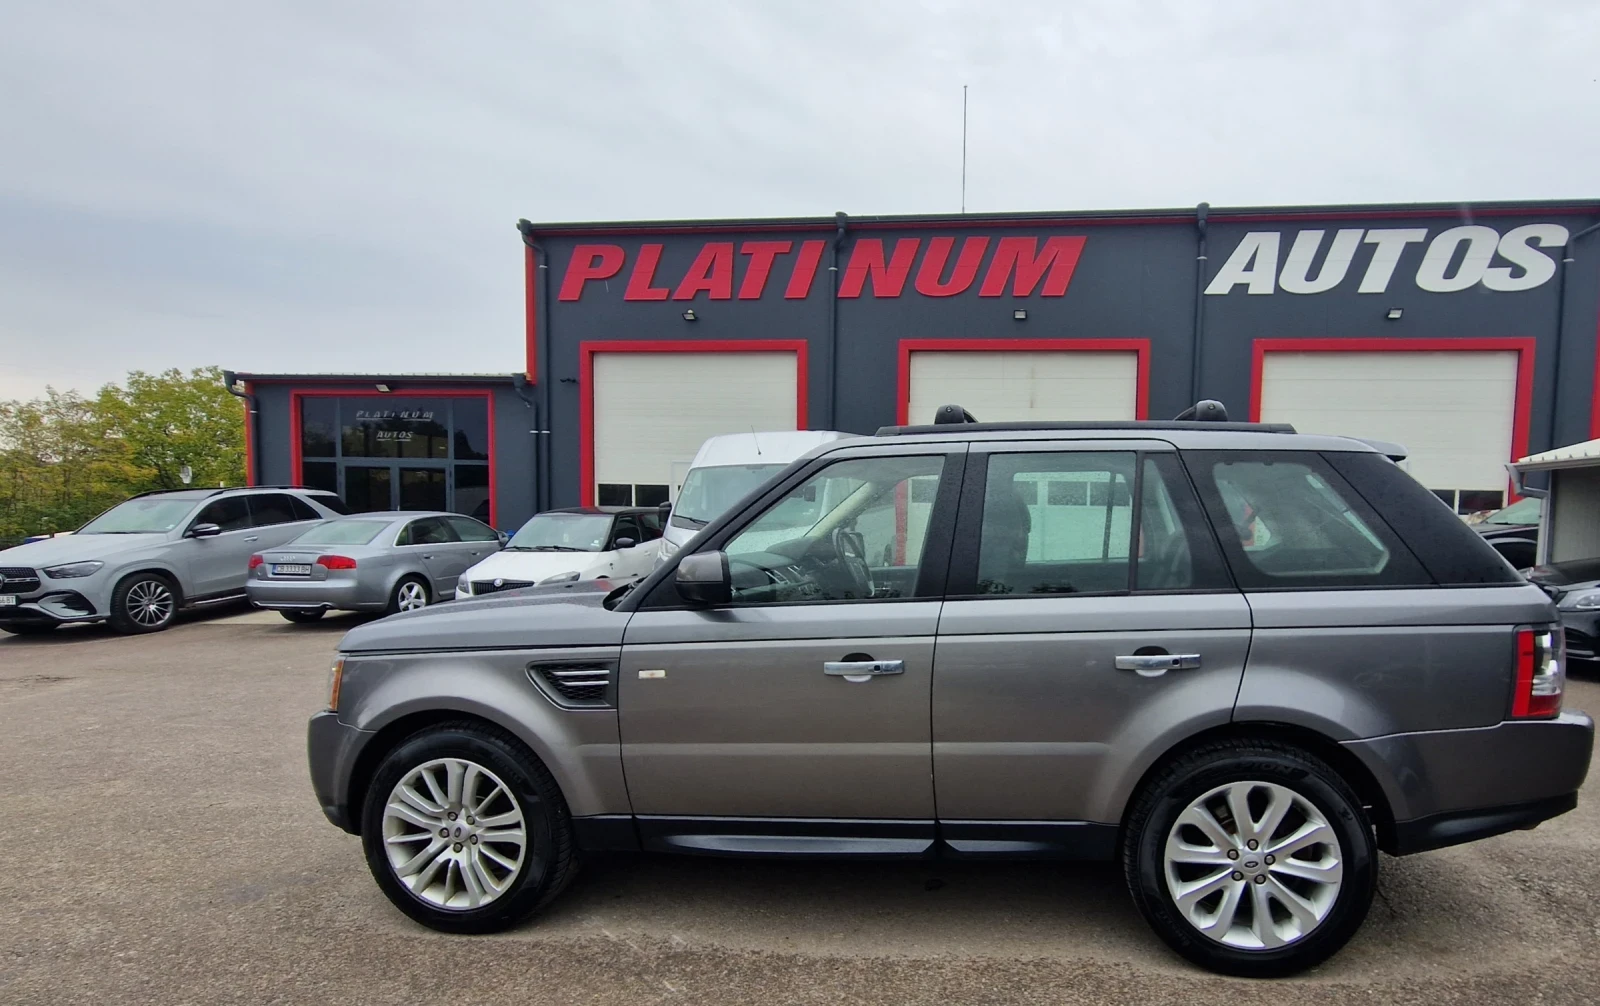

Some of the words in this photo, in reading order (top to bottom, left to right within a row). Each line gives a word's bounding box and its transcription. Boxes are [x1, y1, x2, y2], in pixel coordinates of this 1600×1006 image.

[557, 235, 1088, 301] PLATINUM
[1204, 223, 1570, 295] AUTOS
[356, 410, 434, 419] PLATINUM
[376, 431, 414, 439] AUTOS
